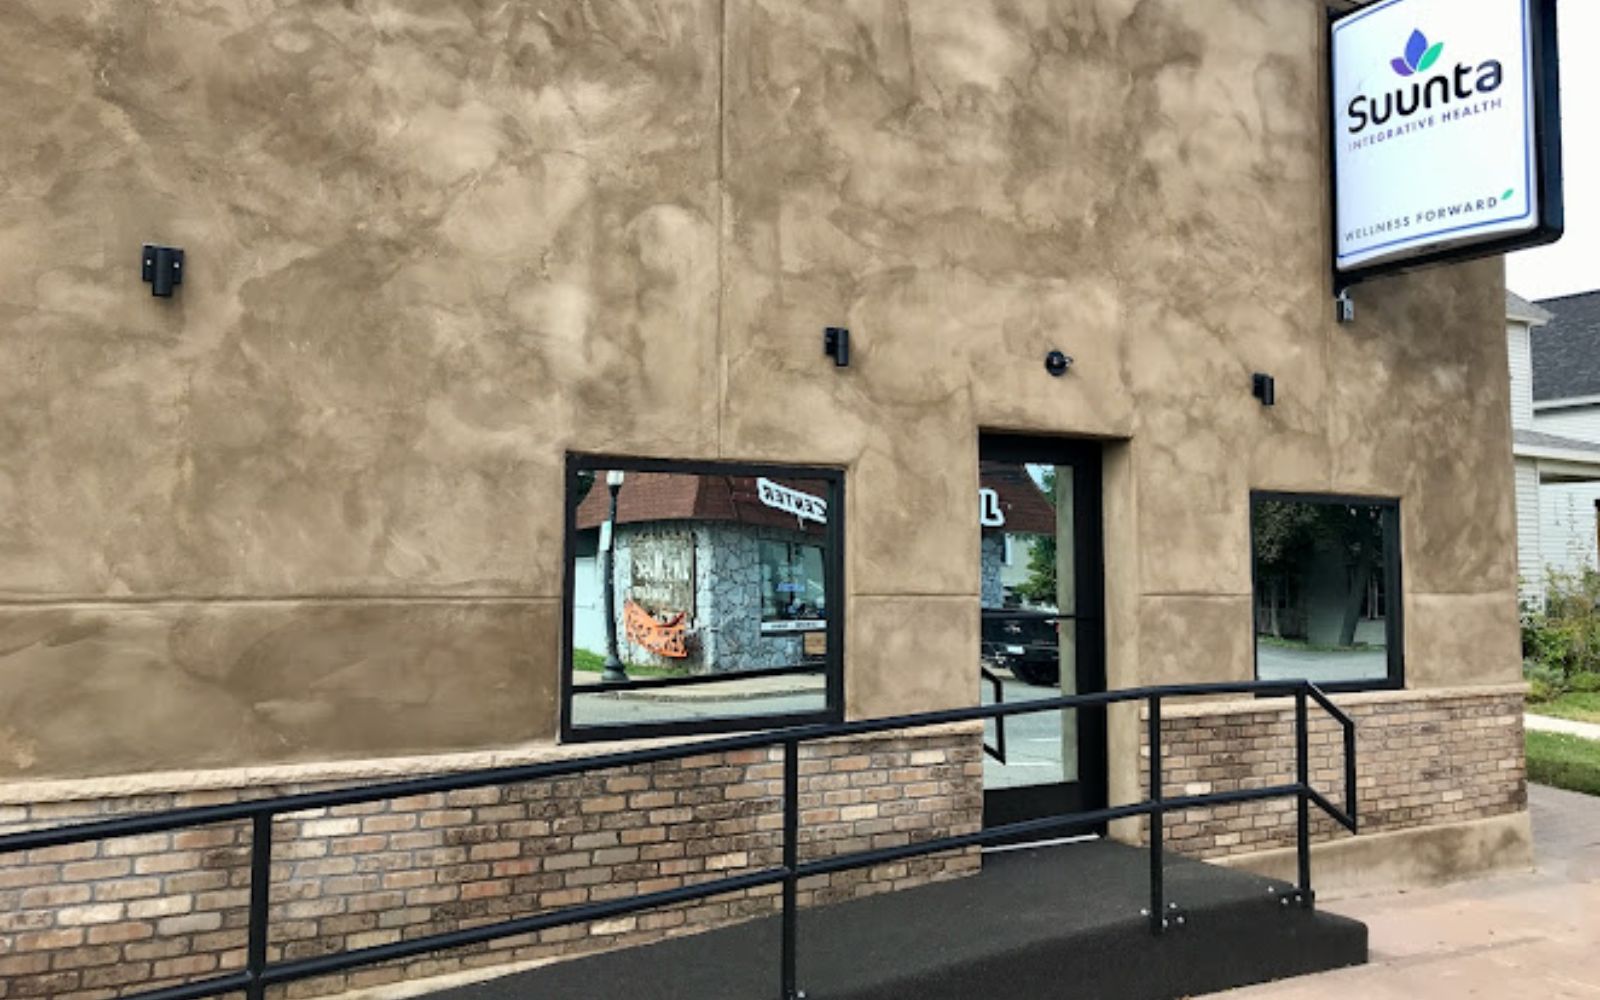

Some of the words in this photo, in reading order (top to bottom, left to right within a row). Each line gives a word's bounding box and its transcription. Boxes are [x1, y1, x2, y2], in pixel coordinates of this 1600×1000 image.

[1348, 59, 1503, 134] Suunta
[1349, 116, 1435, 151] INTEGRATIVE
[1442, 98, 1502, 123] HEALTH
[1345, 216, 1410, 242] WELLNESS
[1416, 197, 1497, 223] FORWARD
